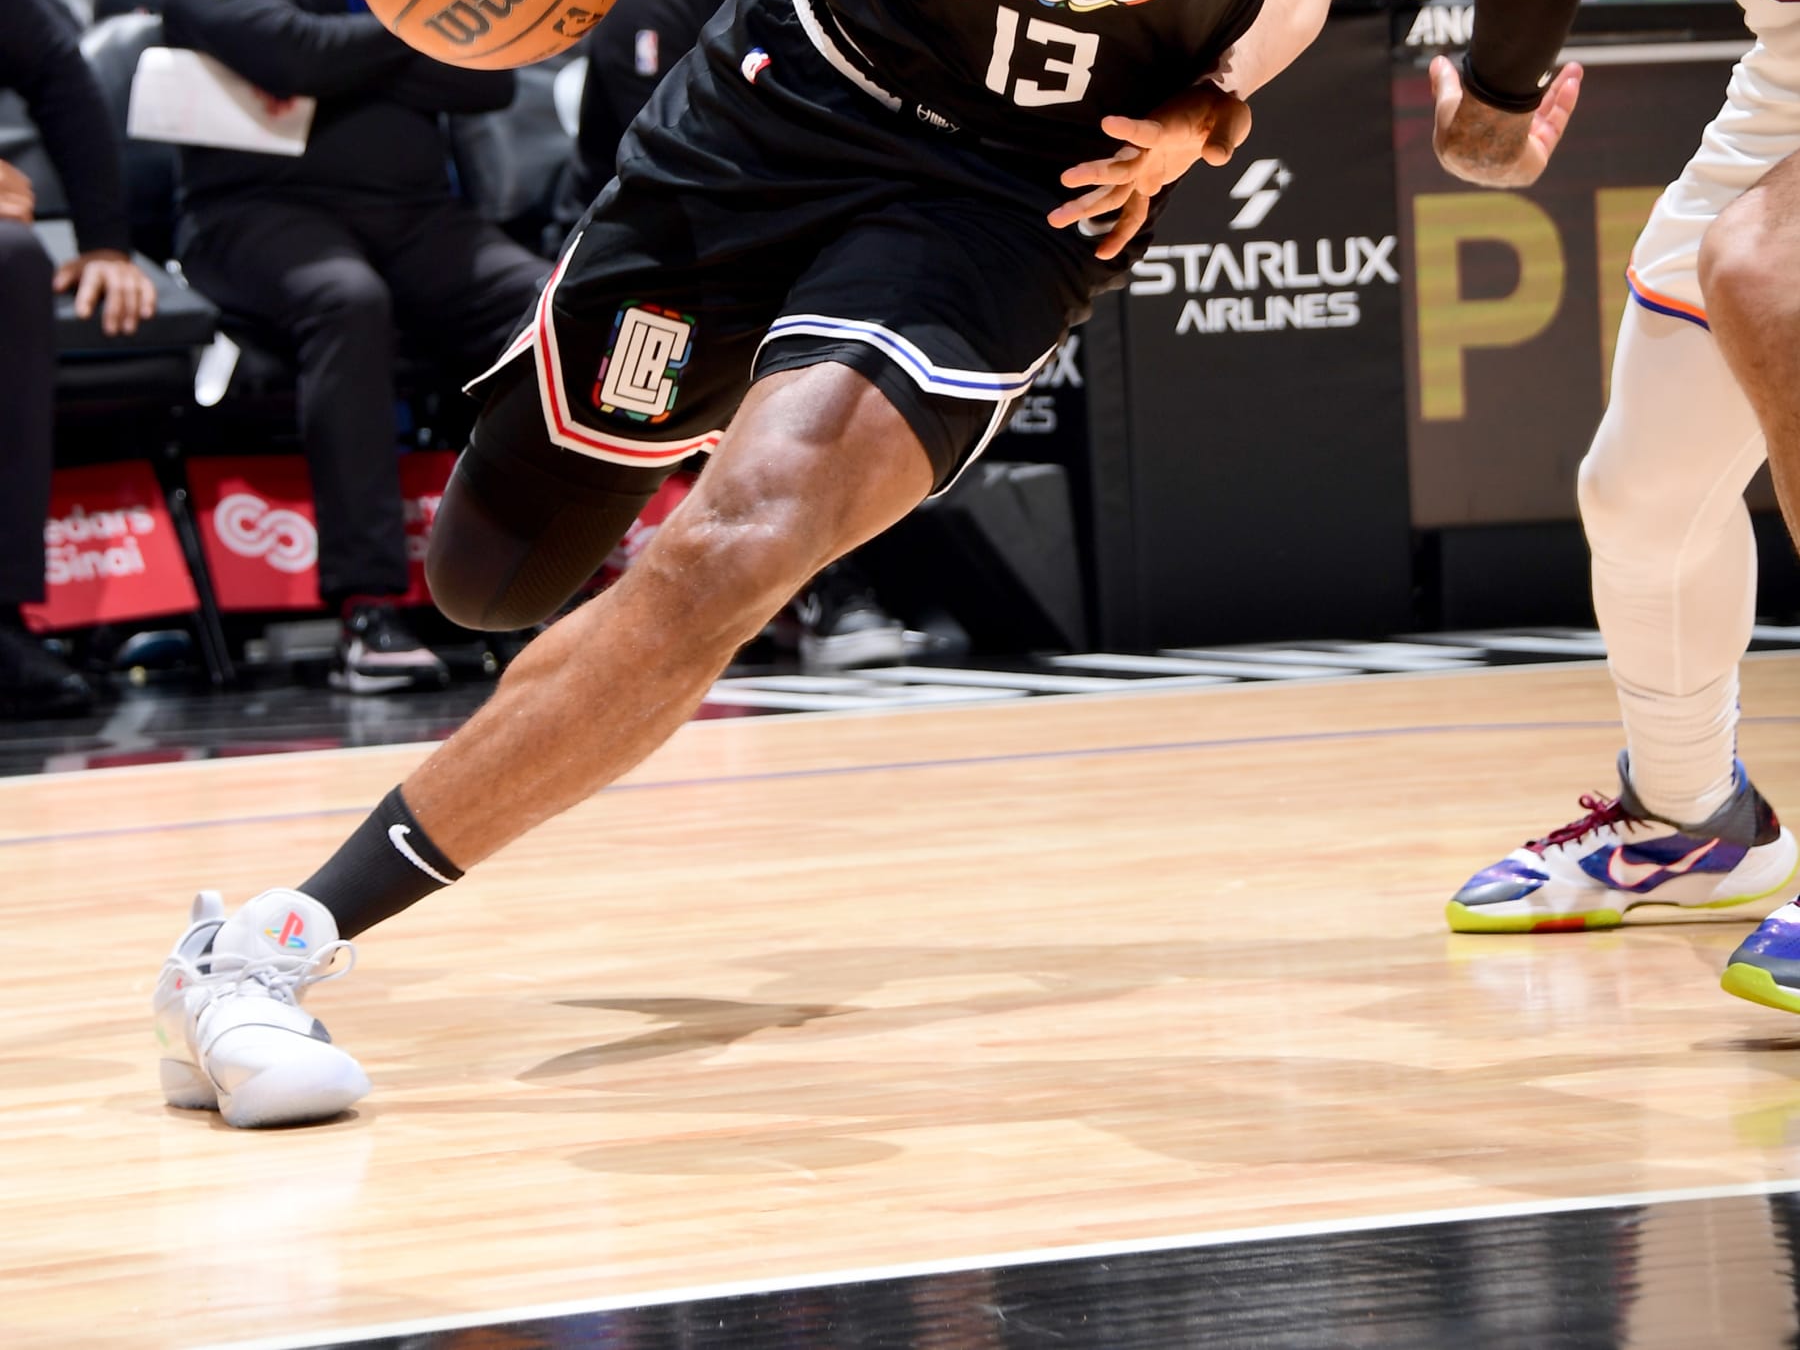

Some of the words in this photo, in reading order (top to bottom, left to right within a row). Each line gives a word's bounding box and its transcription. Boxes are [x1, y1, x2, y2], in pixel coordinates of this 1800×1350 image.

[985, 4, 1100, 107] 13
[1129, 234, 1399, 296] STARLUX
[1175, 291, 1361, 335] AIRLINES
